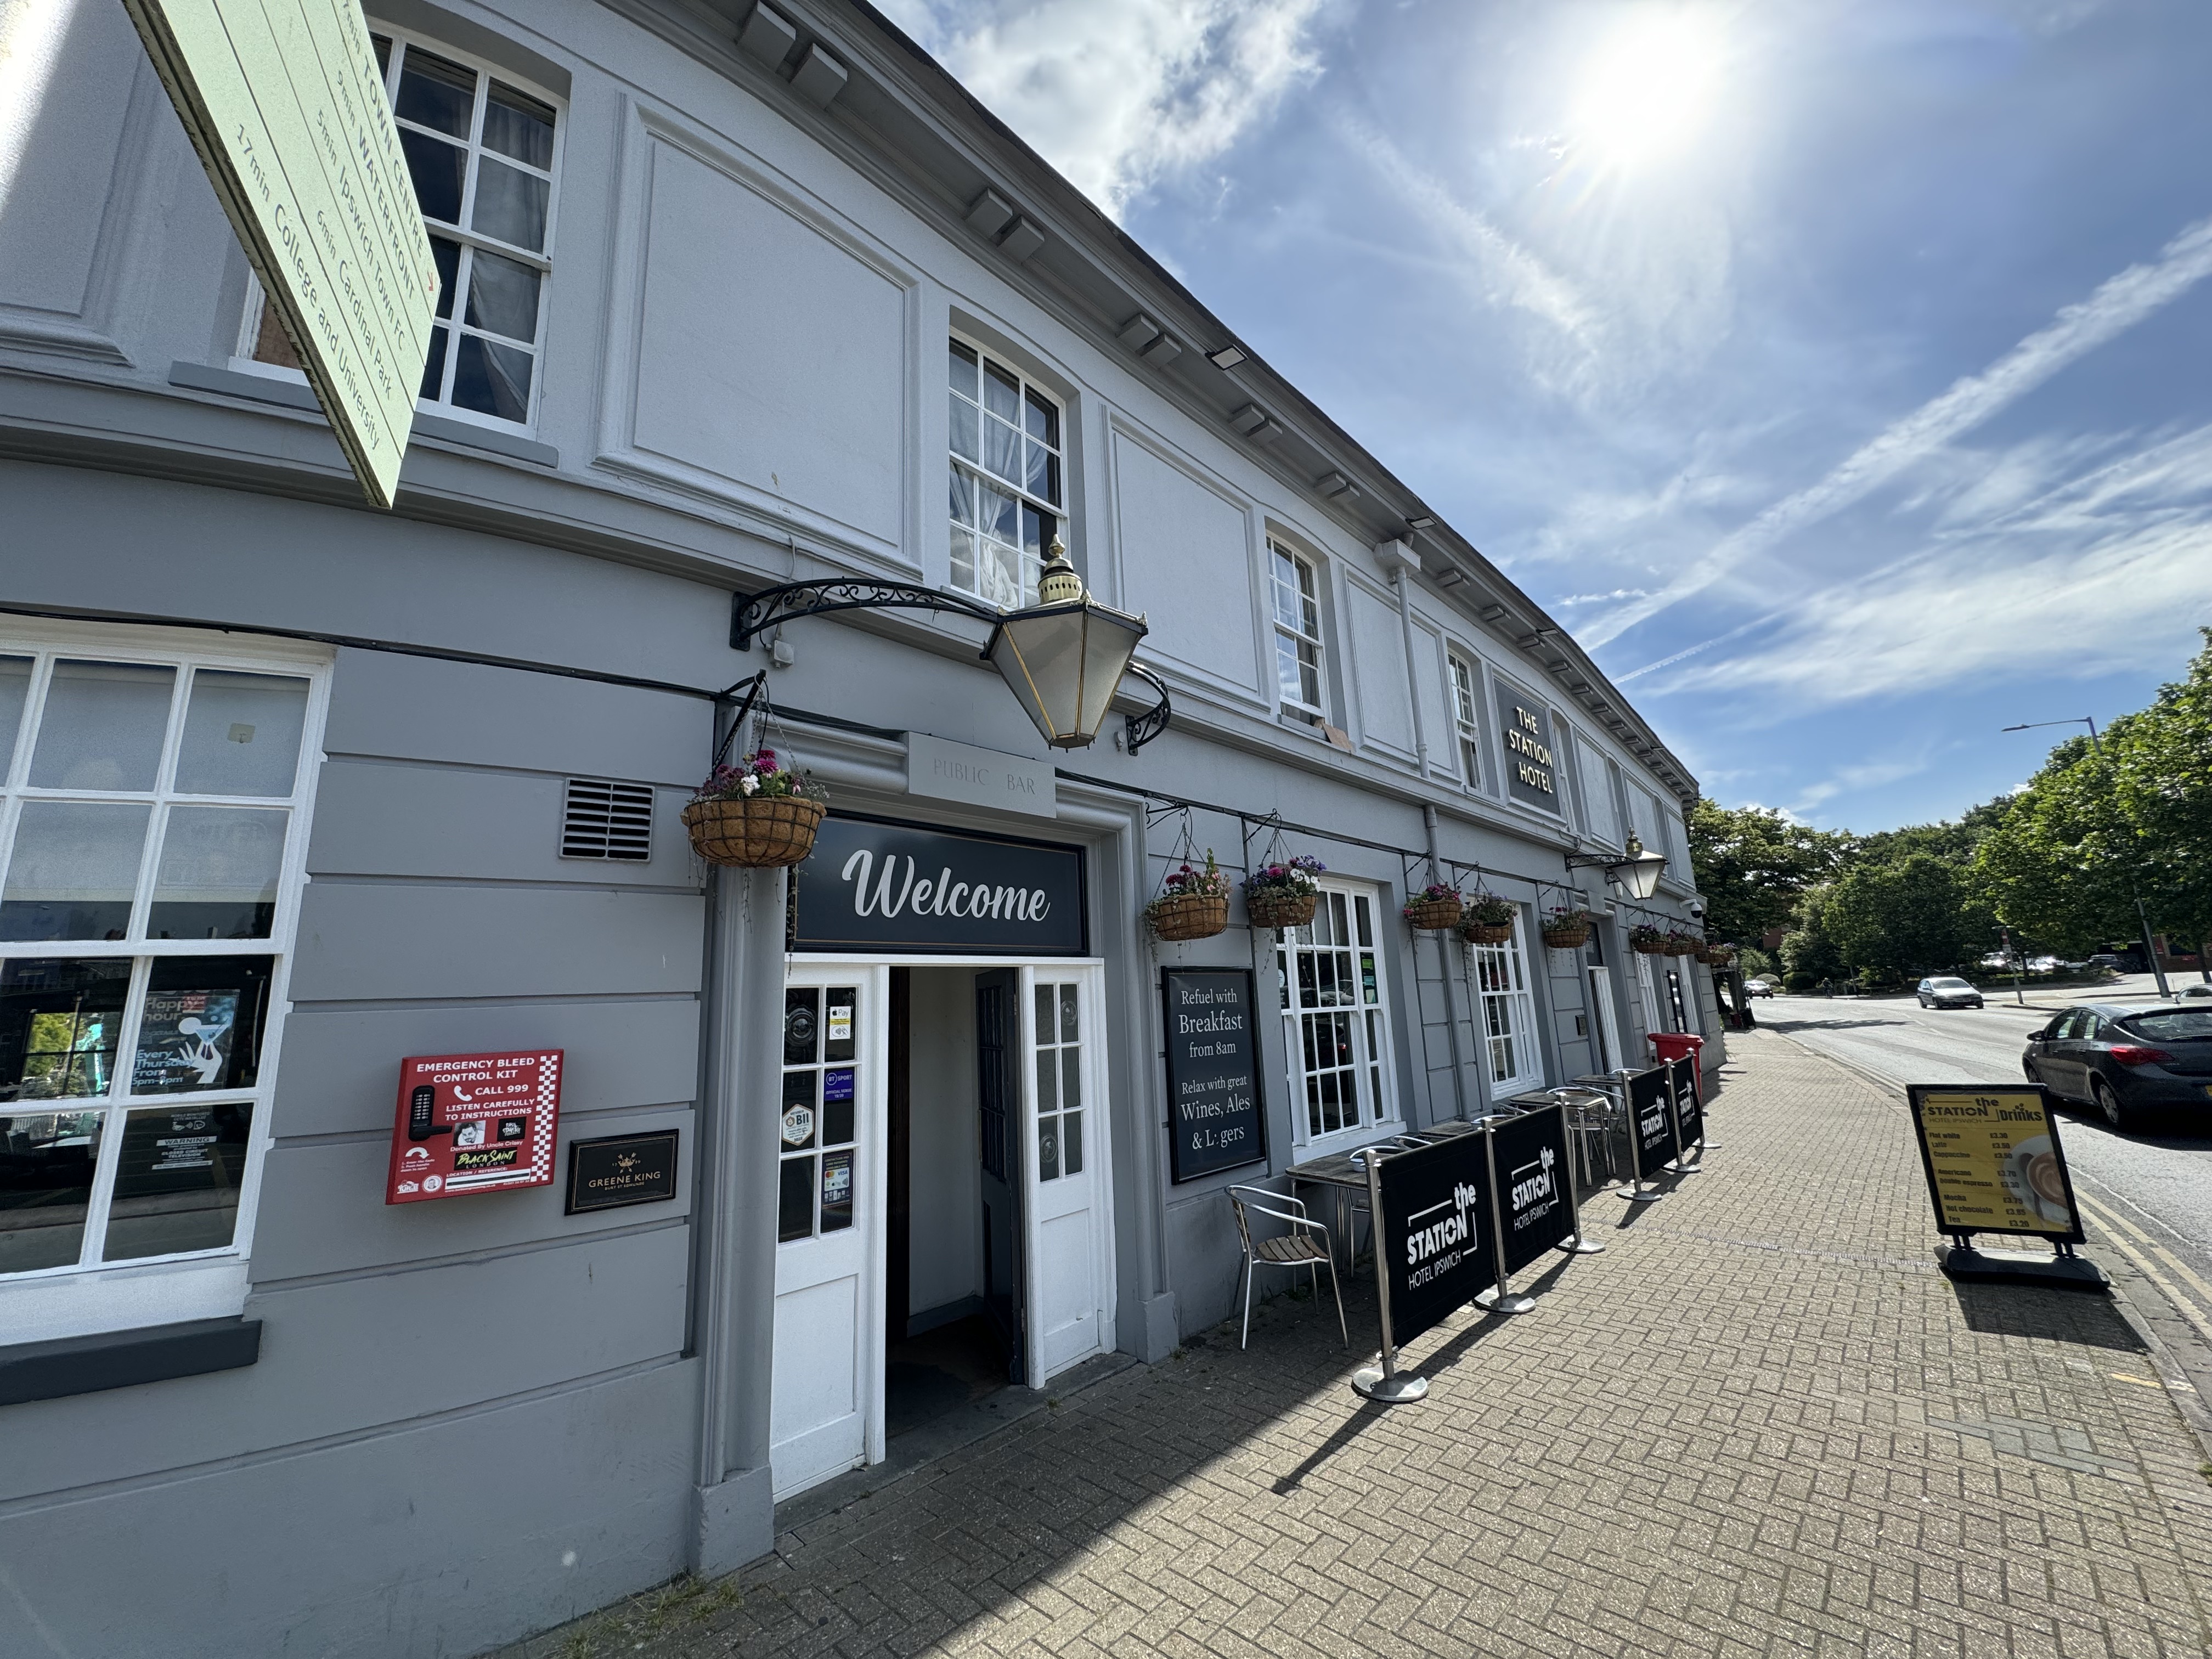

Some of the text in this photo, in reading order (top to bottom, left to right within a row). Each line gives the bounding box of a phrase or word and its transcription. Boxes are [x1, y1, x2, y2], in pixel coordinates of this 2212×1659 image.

[363, 54, 393, 155] TOWN
[393, 159, 423, 258] CENTRE
[337, 70, 414, 299] 9min WATERFRONT
[317, 109, 405, 351] 5min Ipswich Town FC
[238, 123, 380, 450] 17min College and University
[317, 210, 392, 401] 6min Cardinal Park
[1516, 706, 1538, 735] THE
[1509, 729, 1553, 768] STATION
[934, 758, 1035, 795] PUBLIC BAR
[1519, 761, 1553, 794] HOTEL
[842, 849, 1051, 922] Welcome
[1181, 988, 1238, 1005] Refuel with
[838, 1009, 849, 1018] Pay
[1178, 1010, 1243, 1034] Breakfast
[136, 1049, 173, 1059] Every
[1189, 1042, 1237, 1058] from 8am
[136, 1058, 194, 1069] Thursday
[416, 1058, 535, 1073] EMERGENCY BLEED
[433, 1070, 518, 1083] CONTROL KIT
[1181, 1075, 1248, 1095] Relax with great
[475, 1084, 529, 1096] CALL 999
[446, 1098, 535, 1112] LISTEN CAREFULLY
[461, 1107, 532, 1120] INSTRUCTIONS
[1181, 1093, 1251, 1121] Wines, Ales
[1975, 1097, 1999, 1107] the
[1641, 1113, 1663, 1137] STATION
[1928, 1107, 2042, 1121] STATION Drinks
[165, 1137, 210, 1145] WARNING
[1192, 1132, 1203, 1150] &
[466, 1161, 505, 1169] LONDON
[1540, 1146, 1554, 1169] the
[589, 1171, 661, 1188] GREENE KING
[1454, 1182, 1476, 1210] the
[1512, 1172, 1550, 1211] STATION
[1514, 1201, 1550, 1231] HOTEL IPSWICH
[2008, 1220, 2030, 1228] £3.20
[1407, 1214, 1468, 1265] STATION
[1408, 1249, 1462, 1291] HOTEL IPSWICH
